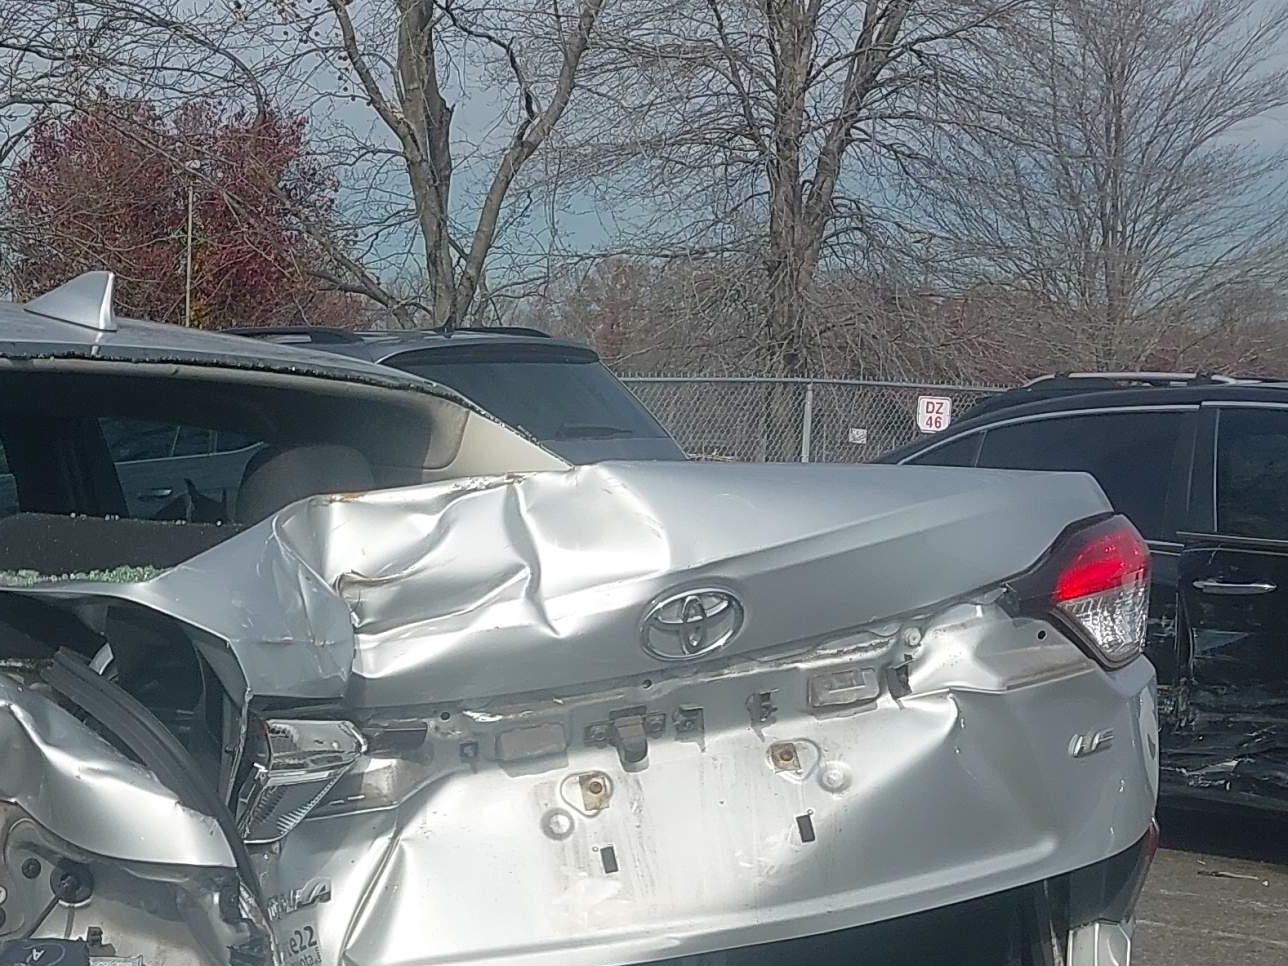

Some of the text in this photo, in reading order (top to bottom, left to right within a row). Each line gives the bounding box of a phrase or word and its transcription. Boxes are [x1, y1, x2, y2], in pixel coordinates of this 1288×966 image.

[925, 401, 944, 415] DZ
[925, 415, 942, 429] 46
[288, 926, 317, 957] e22
